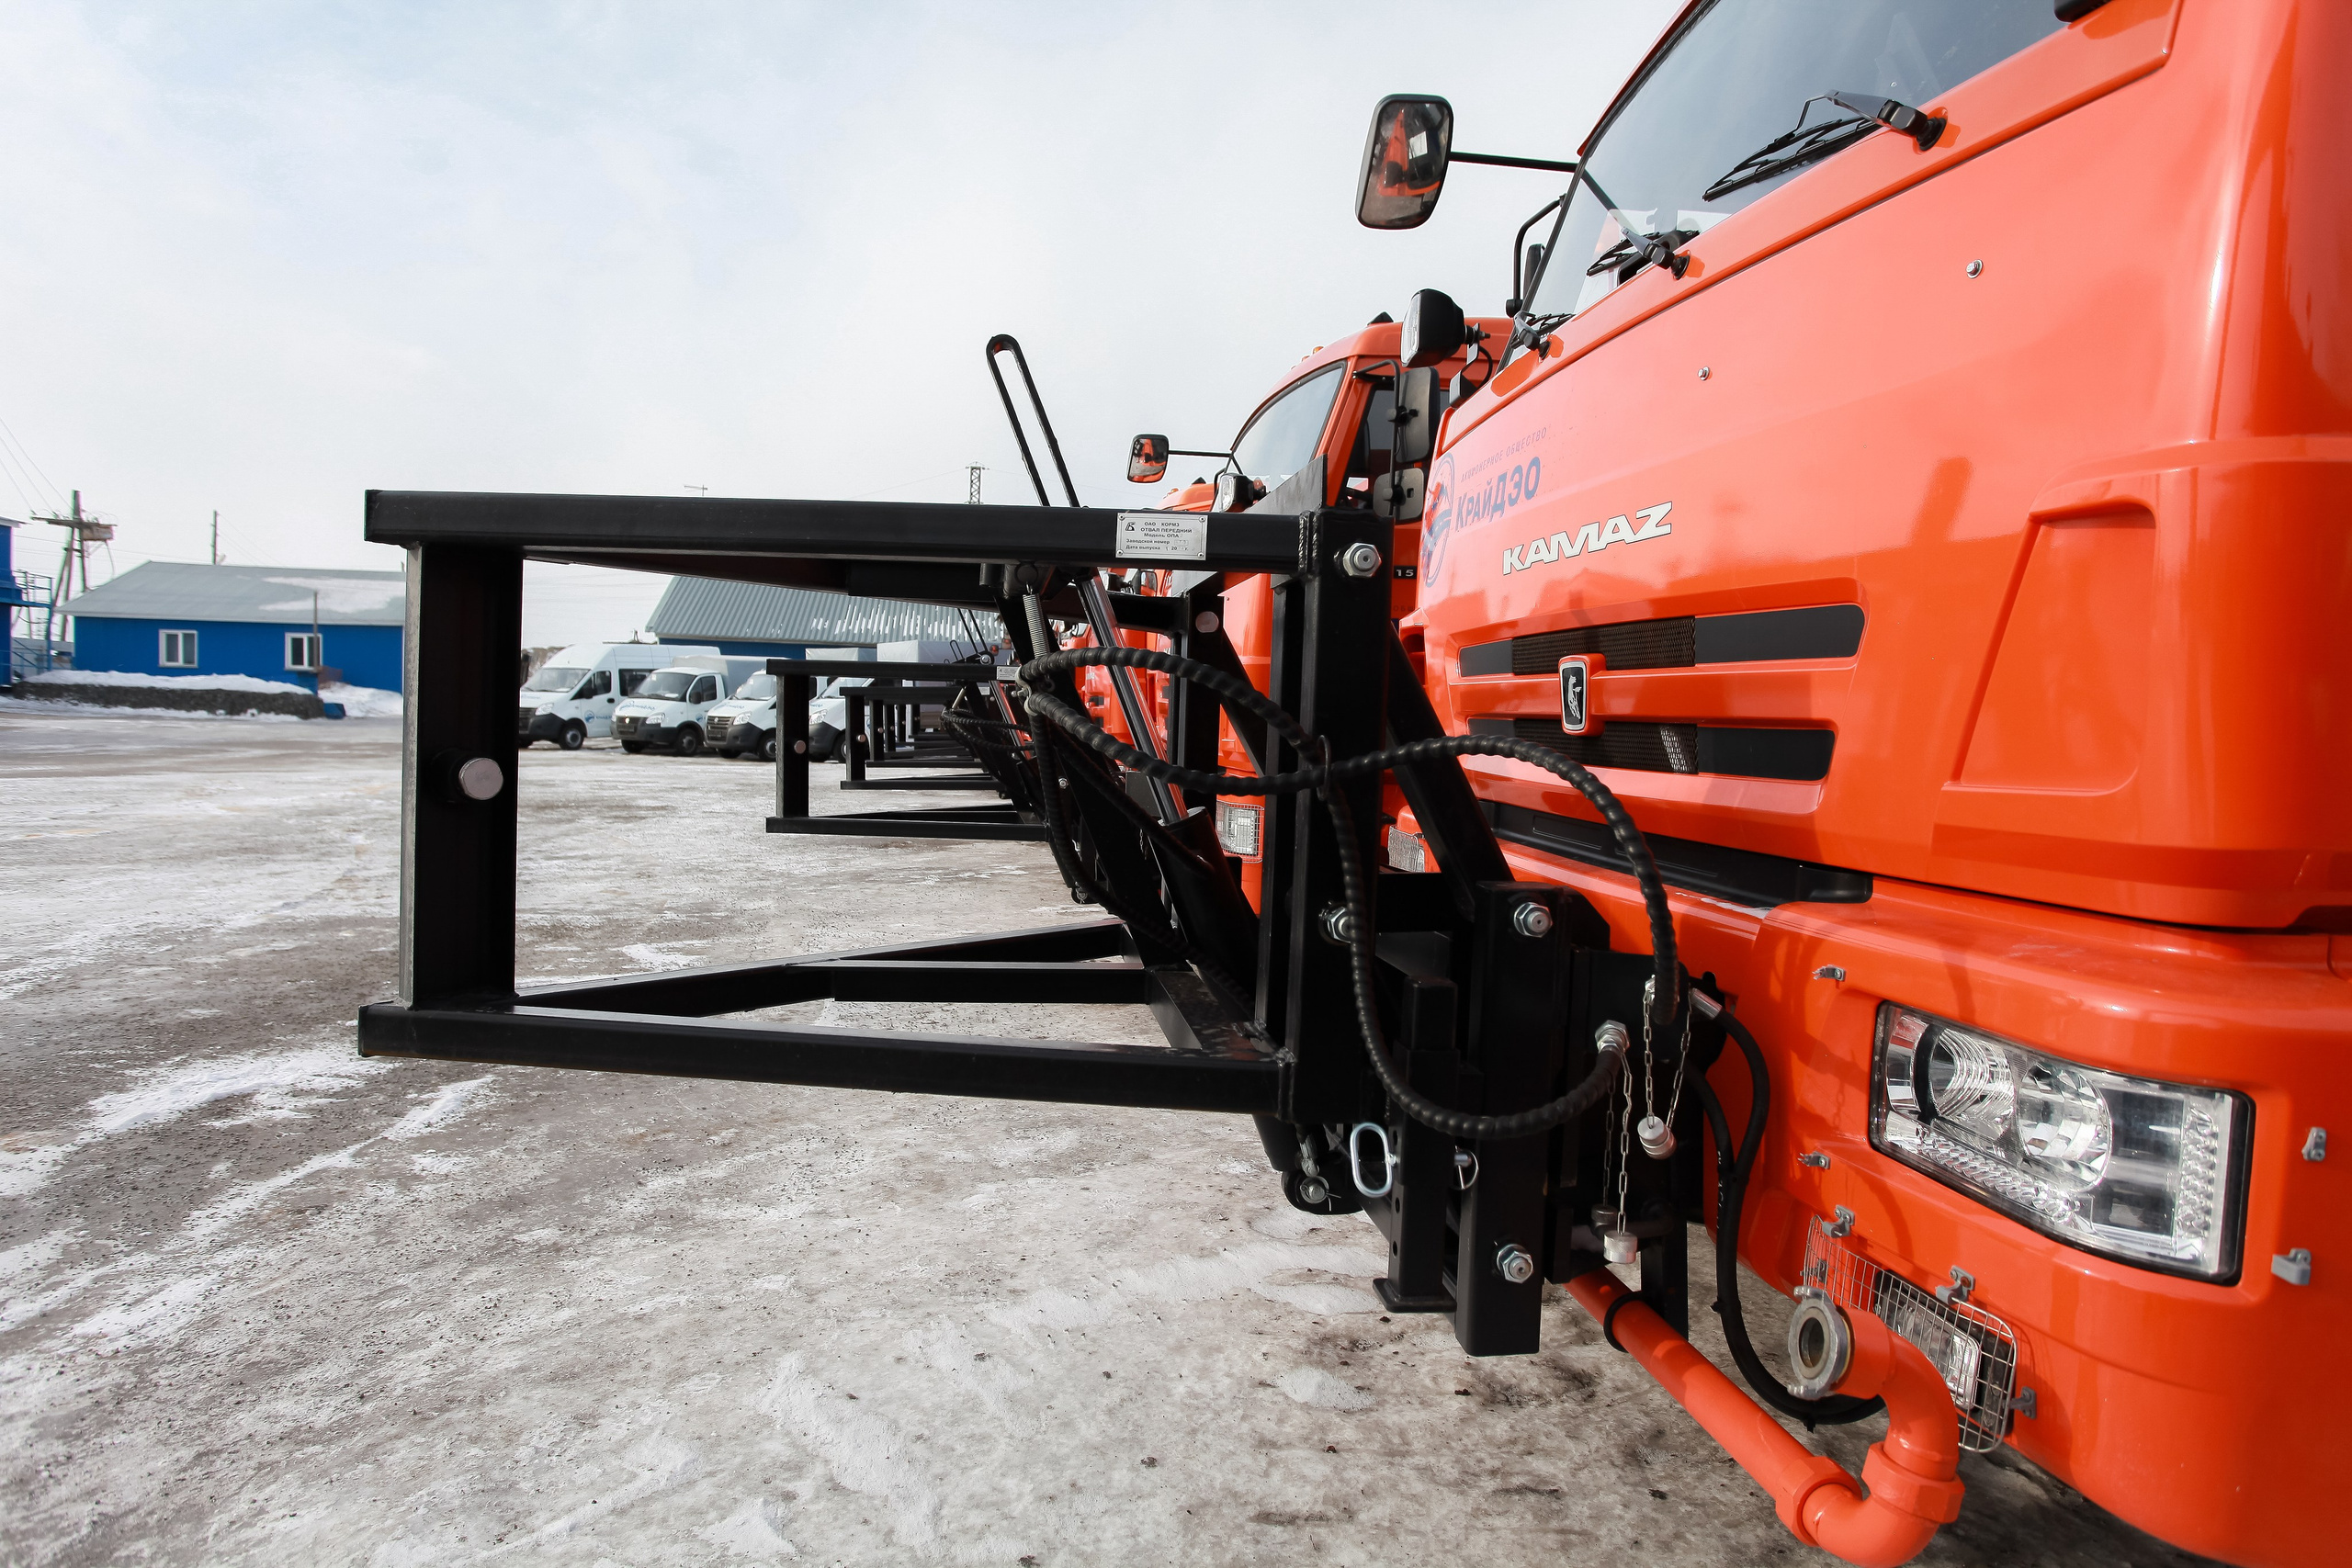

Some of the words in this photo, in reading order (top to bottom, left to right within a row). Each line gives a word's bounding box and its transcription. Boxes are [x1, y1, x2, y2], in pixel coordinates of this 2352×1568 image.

[1460, 449, 1504, 483] АКЦИОНЕРНОЕ
[1505, 426, 1547, 457] ОБЩЕСТВО
[1502, 501, 1673, 576] KAMAZ
